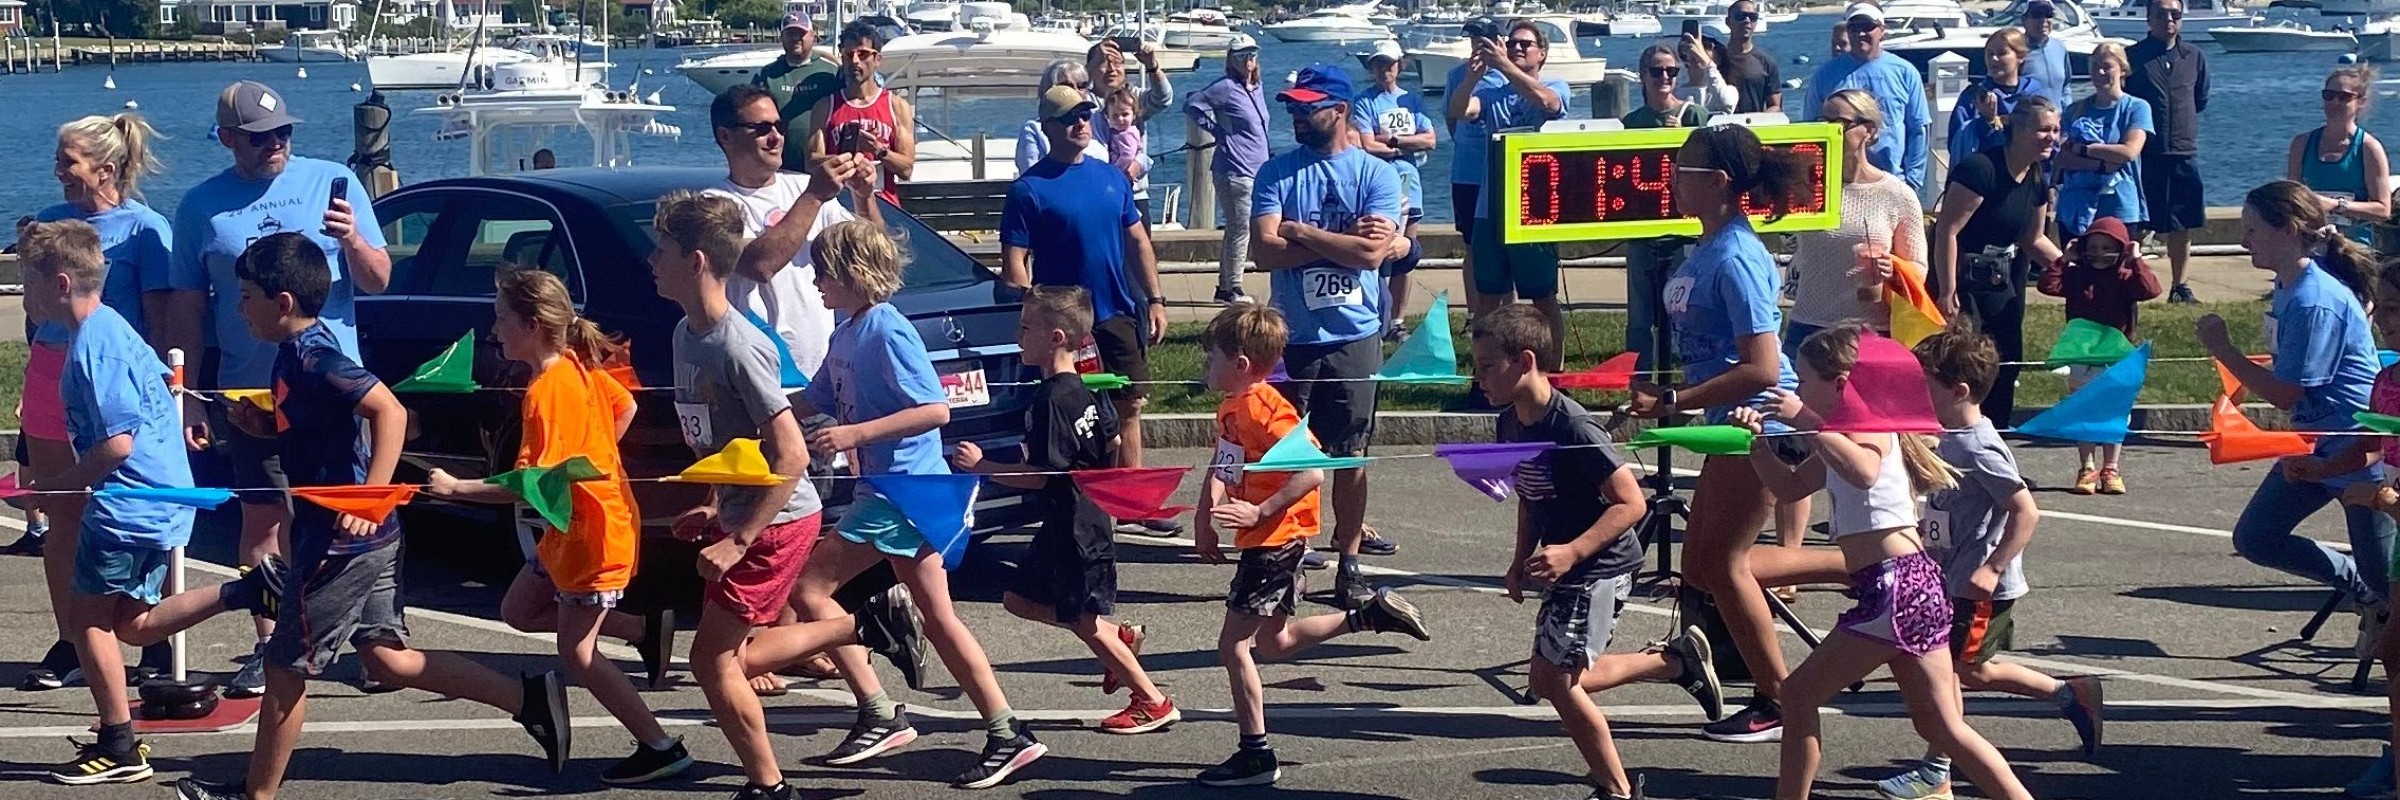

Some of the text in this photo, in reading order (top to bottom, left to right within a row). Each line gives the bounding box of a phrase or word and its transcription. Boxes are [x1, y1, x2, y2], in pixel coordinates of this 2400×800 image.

[1388, 112, 1411, 129] 284
[250, 197, 304, 213] ANNUAL
[1314, 273, 1353, 298] 269
